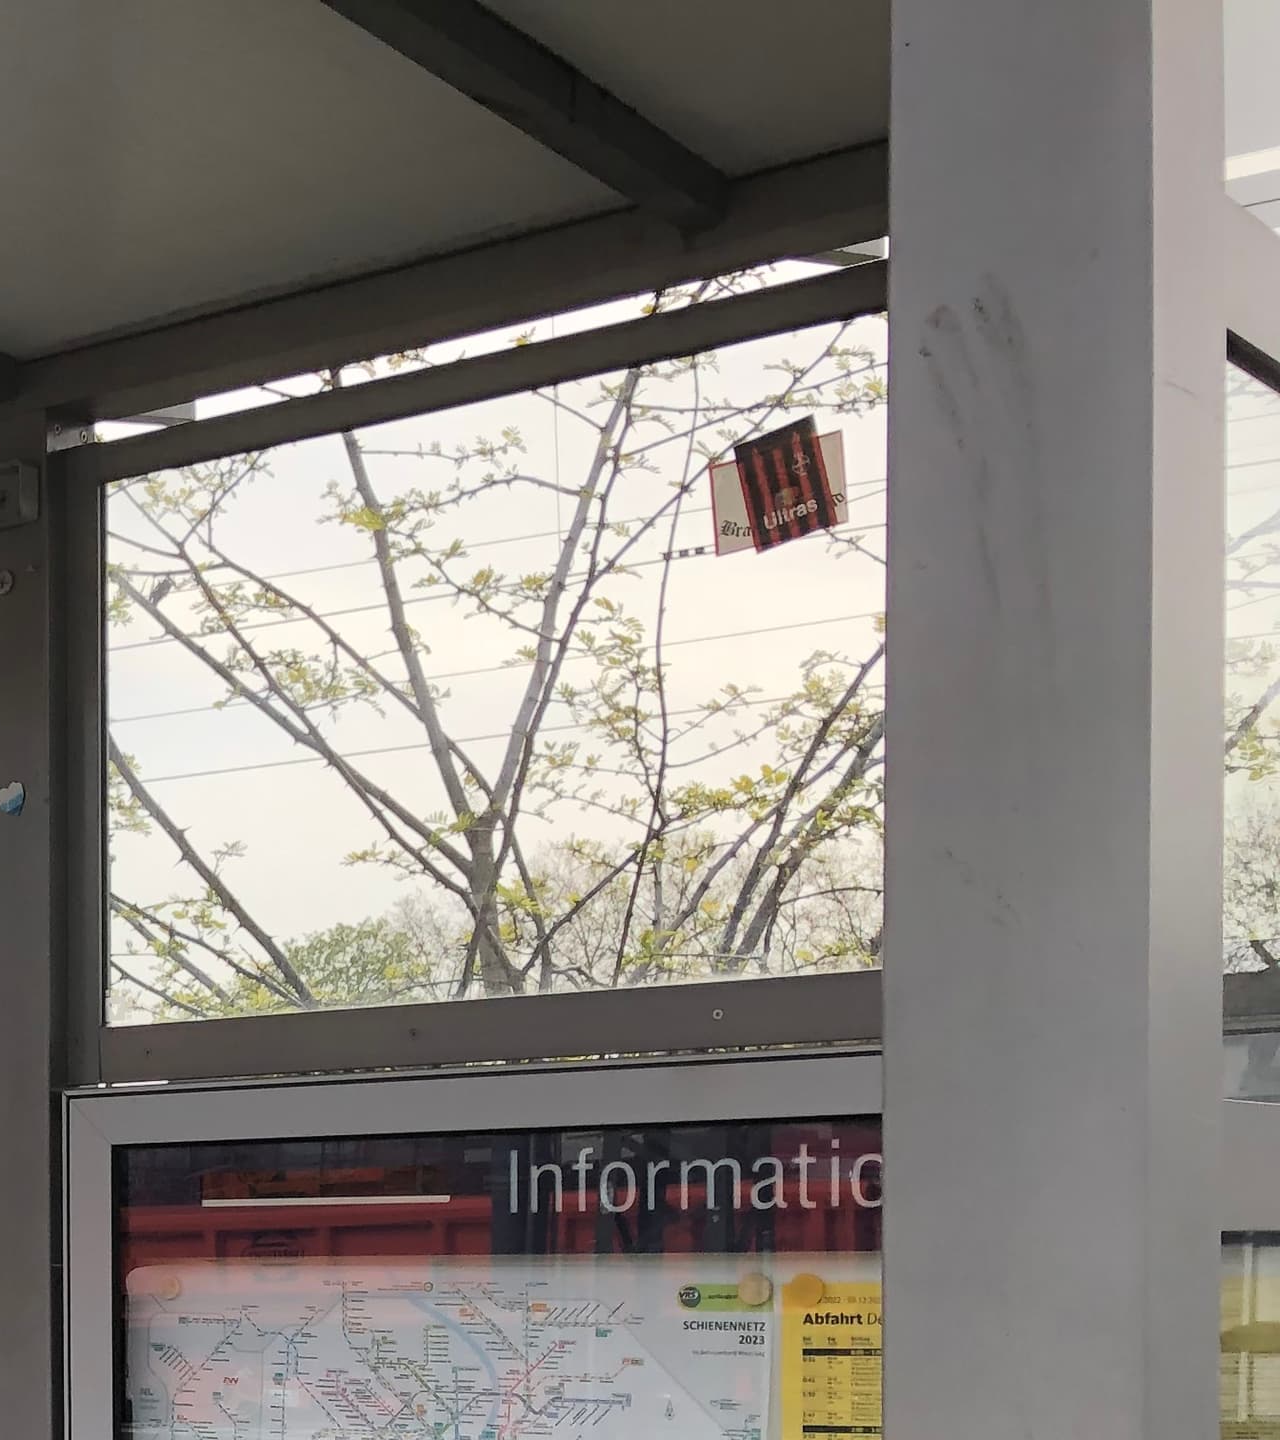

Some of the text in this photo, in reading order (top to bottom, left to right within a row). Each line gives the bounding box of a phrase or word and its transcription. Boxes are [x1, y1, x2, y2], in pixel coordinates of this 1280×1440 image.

[762, 498, 819, 530] Ultras
[802, 1312, 863, 1325] Abfahrt
[682, 1320, 766, 1332] SCHIENENNETZ
[738, 1334, 765, 1345] 2023
